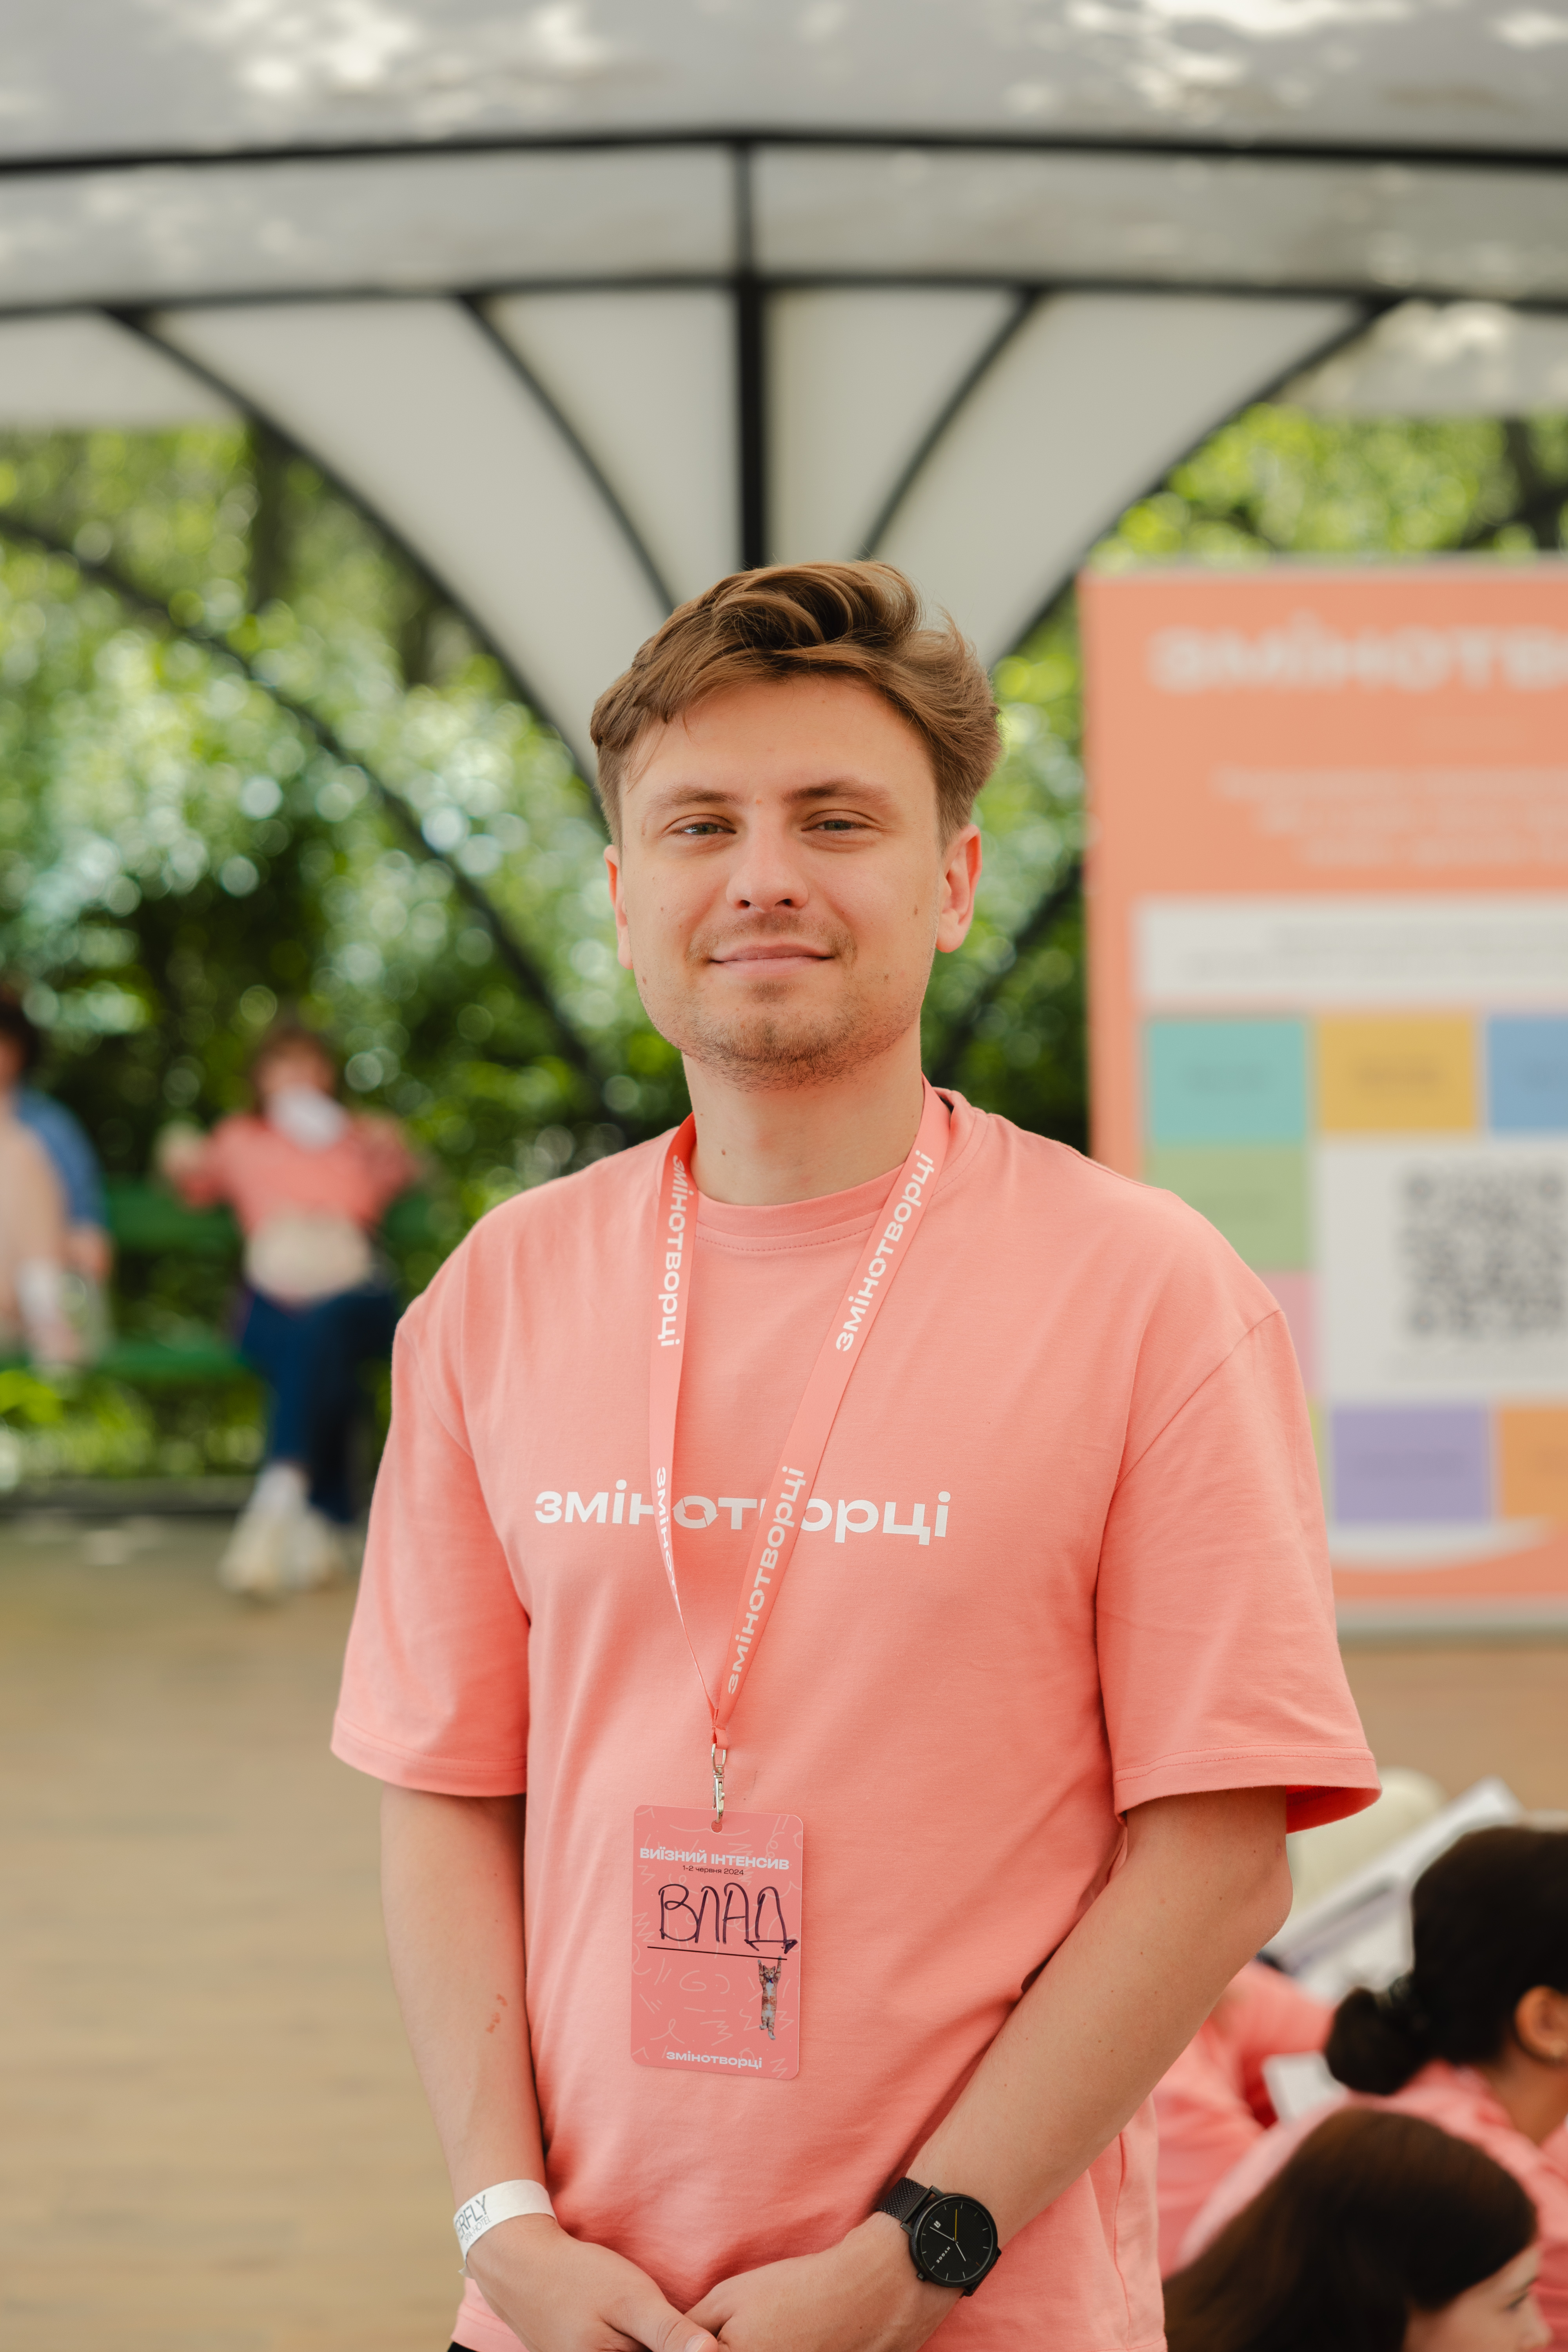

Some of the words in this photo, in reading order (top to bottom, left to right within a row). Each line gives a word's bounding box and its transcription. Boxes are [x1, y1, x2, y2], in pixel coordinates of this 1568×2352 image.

[835, 1149, 935, 1352] змінотворці
[534, 1479, 951, 1545] зміноторці
[728, 1465, 806, 1695] змінотворці
[640, 1847, 708, 1864] ВИЇЗНИЙ
[711, 1853, 789, 1870] ІНТЕНСИВ
[666, 2051, 762, 2069] змінотворці
[455, 2194, 487, 2242] ERFLY
[936, 2246, 951, 2263] HYGGE
